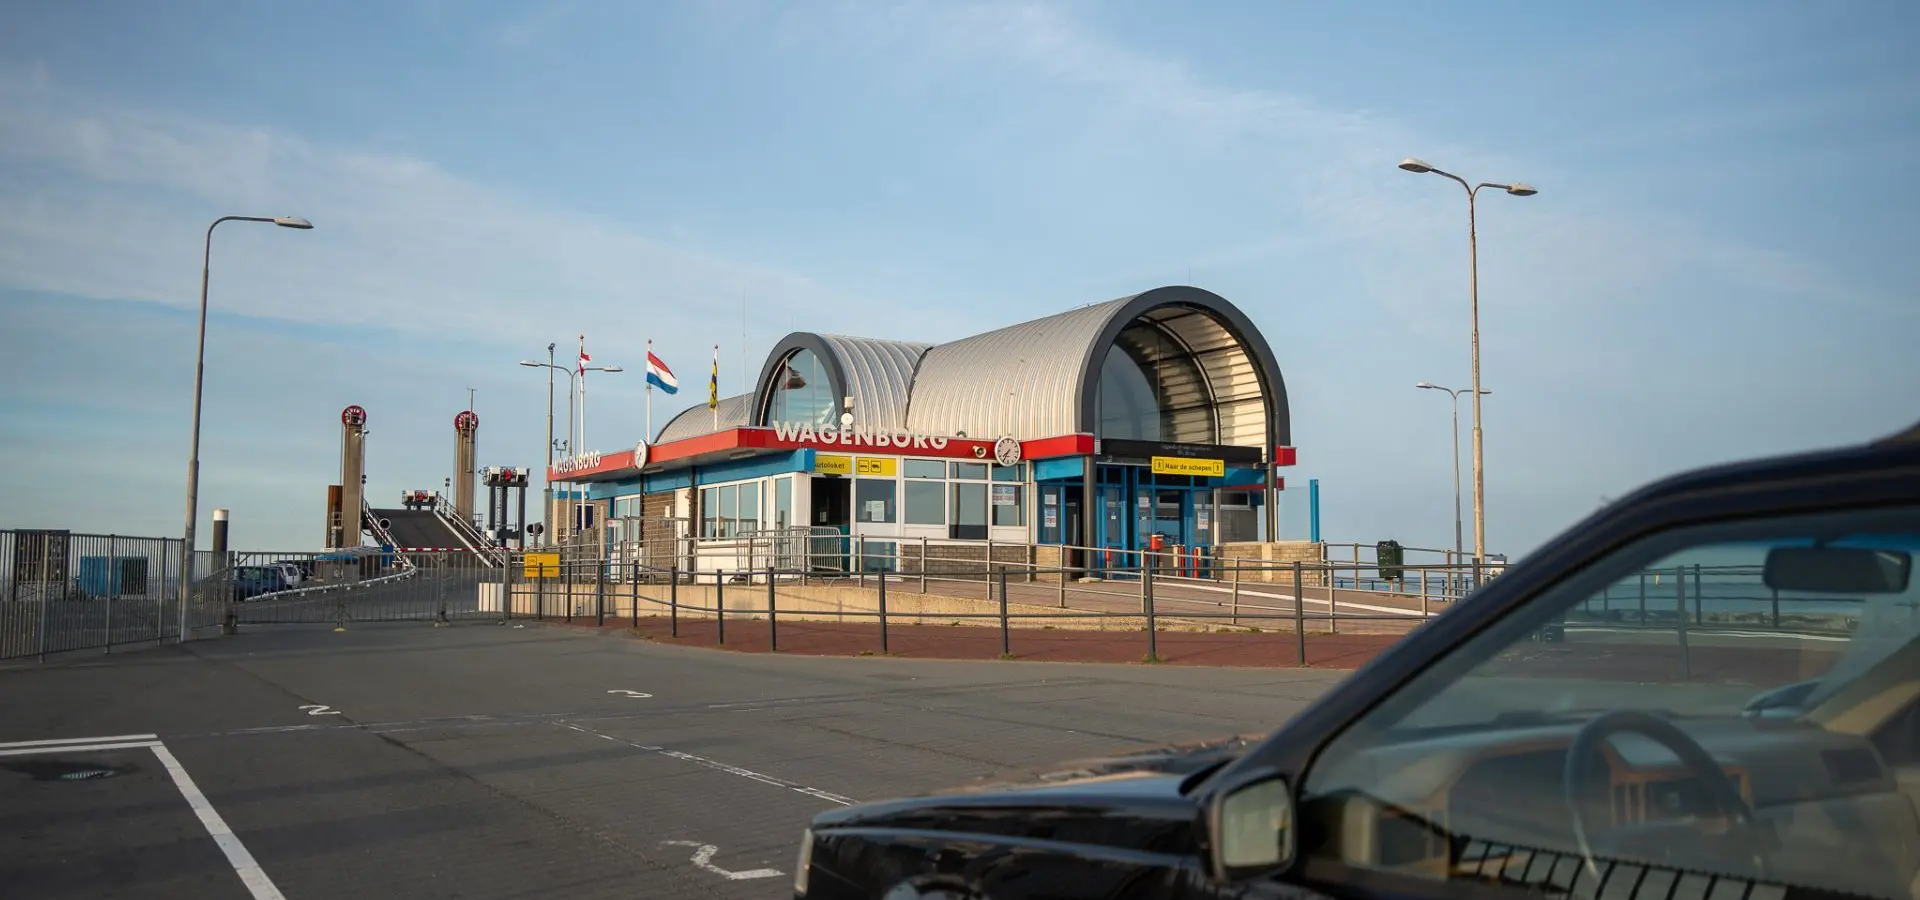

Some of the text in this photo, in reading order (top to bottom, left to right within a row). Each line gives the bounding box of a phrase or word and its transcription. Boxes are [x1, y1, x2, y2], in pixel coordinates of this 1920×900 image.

[773, 420, 948, 450] WAGENBORG
[552, 450, 601, 475] WAGENBORG
[814, 461, 845, 469] utoloket
[298, 705, 341, 716] 2
